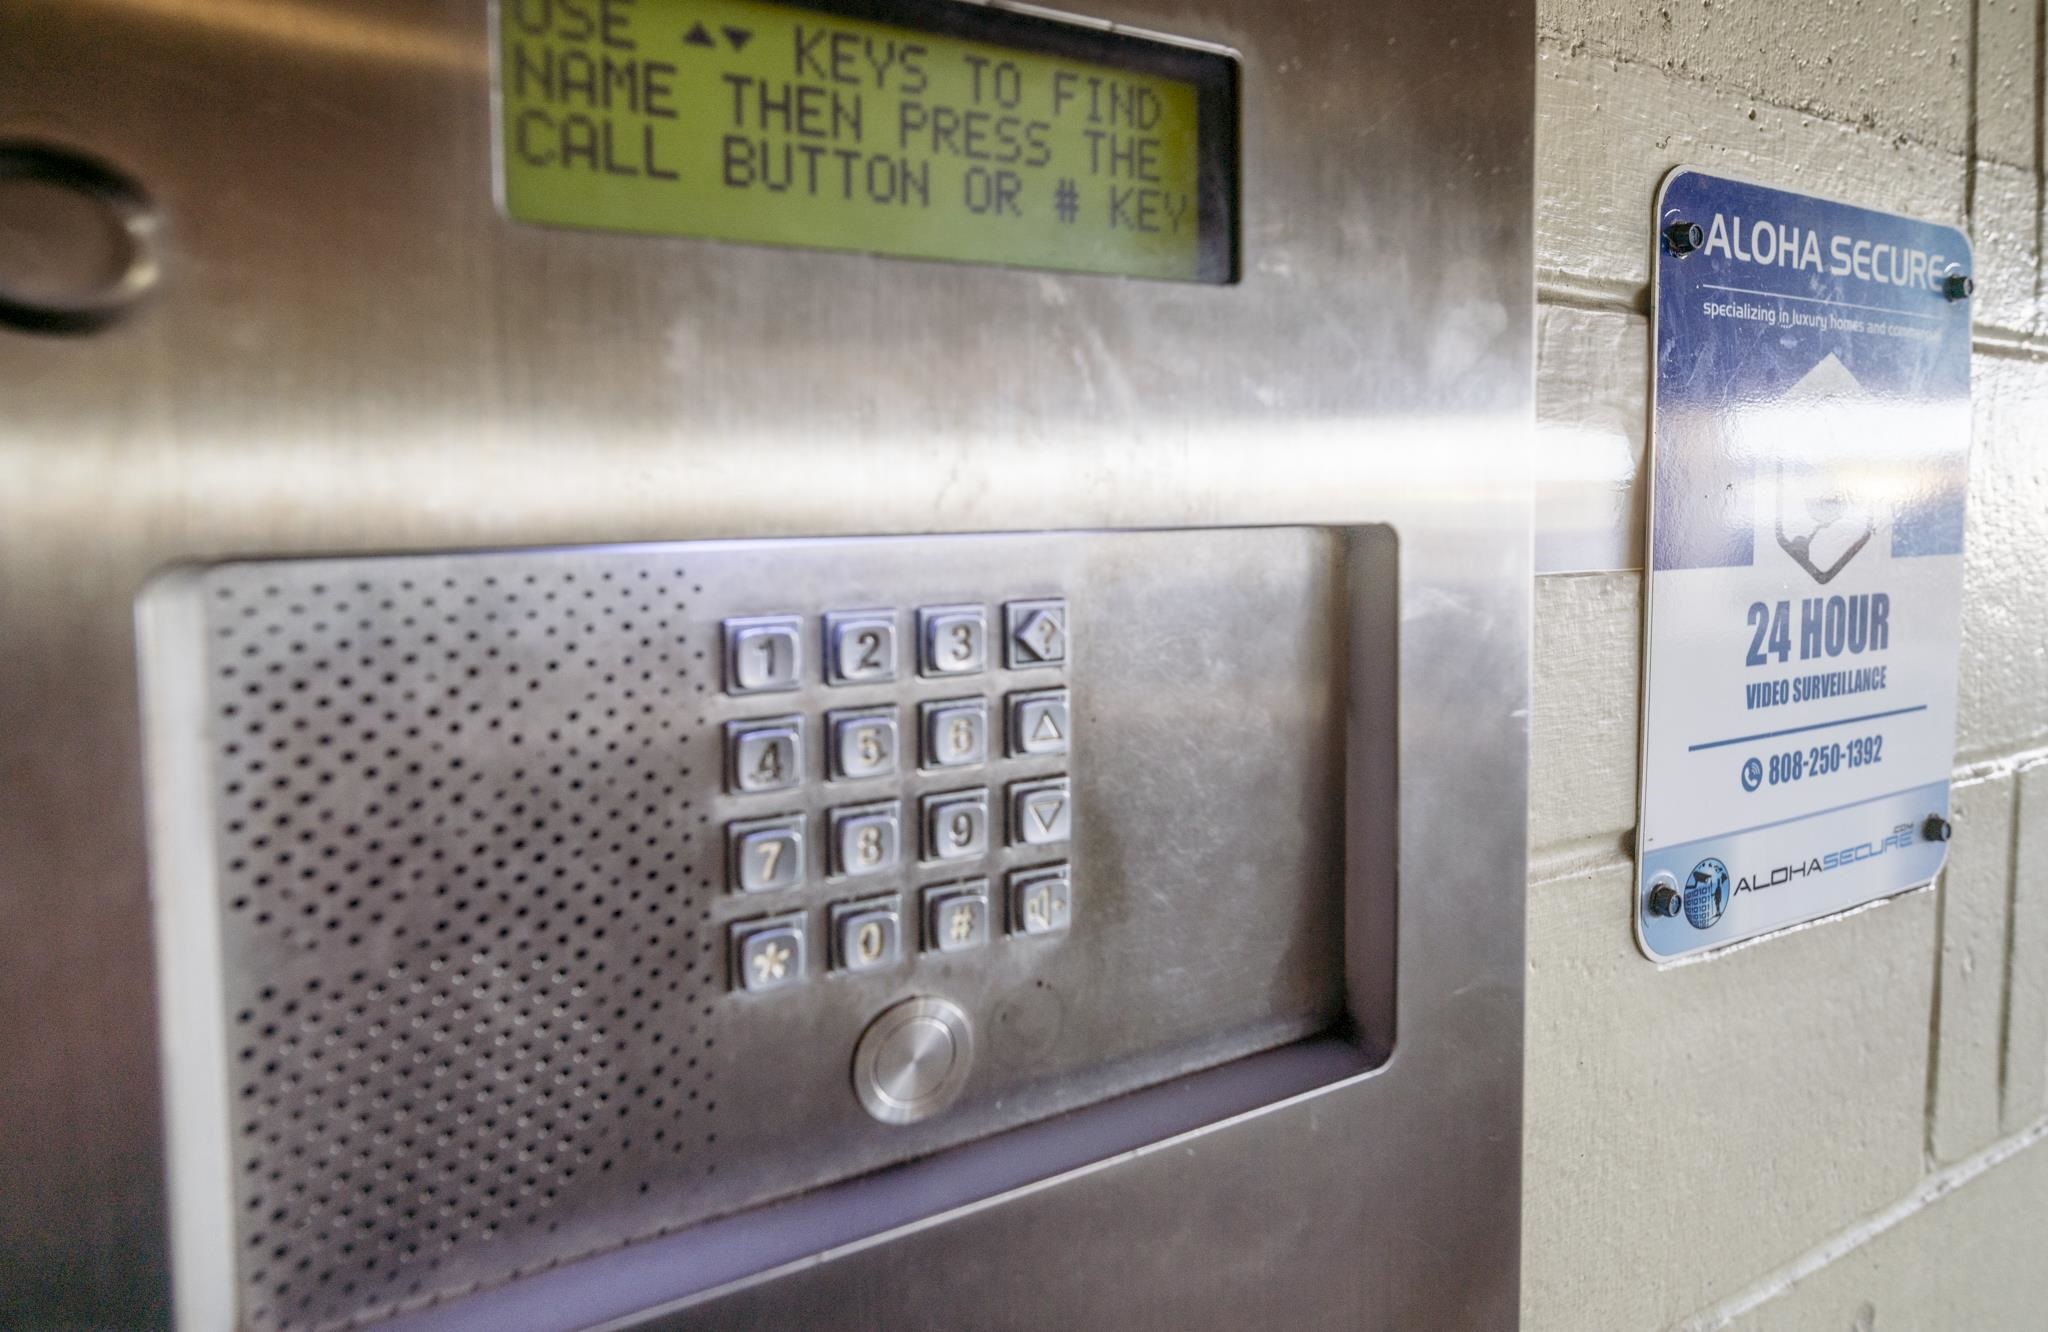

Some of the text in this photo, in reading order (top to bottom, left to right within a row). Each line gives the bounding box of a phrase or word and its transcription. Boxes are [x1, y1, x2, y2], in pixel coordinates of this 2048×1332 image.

[514, 0, 1162, 132] USE KEYS TO FIND
[514, 43, 1161, 182] NAME THEN PRESS THE
[514, 109, 1188, 233] CALL BUTTON OR # KEY
[1704, 213, 1945, 292] ALOHA SECURE
[1703, 302, 1776, 326] specializing
[1779, 307, 1789, 324] in
[1792, 308, 1828, 331] luxury
[1830, 314, 1865, 333] homes
[1866, 322, 1887, 336] and
[857, 632, 881, 670] 2
[951, 624, 972, 660] 3
[1745, 592, 1890, 667] 24 HOUR
[1746, 666, 1886, 710] VIDEO SURVEILLANCE
[755, 719, 972, 782] 4 5 6
[1768, 735, 1883, 786] 808-250-1392
[756, 812, 972, 881] 7 8 9
[858, 924, 884, 961] 0
[950, 907, 974, 941] #
